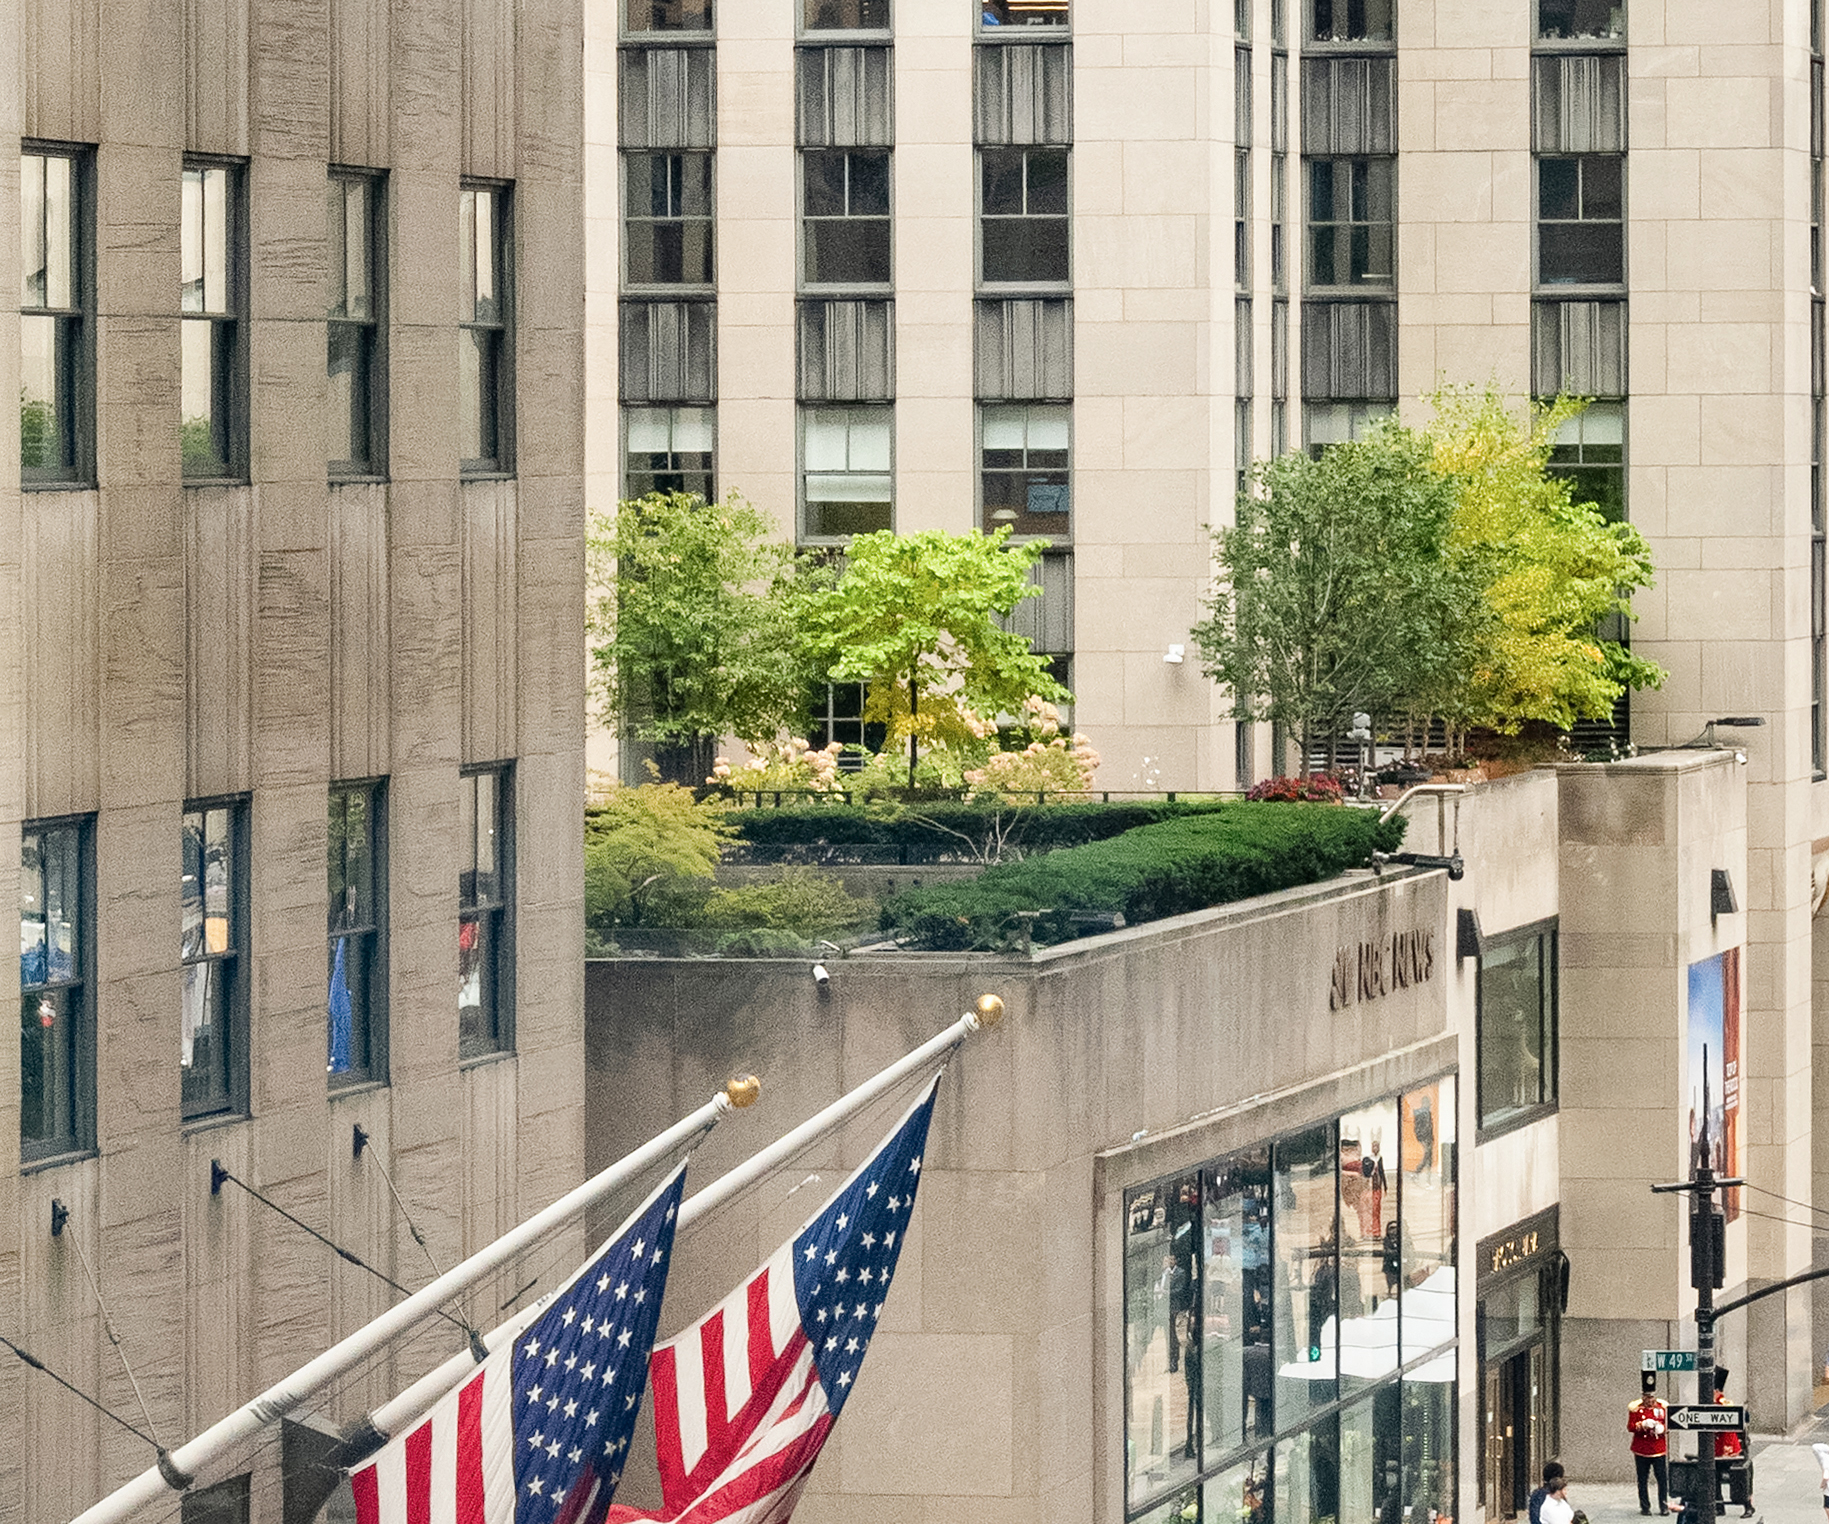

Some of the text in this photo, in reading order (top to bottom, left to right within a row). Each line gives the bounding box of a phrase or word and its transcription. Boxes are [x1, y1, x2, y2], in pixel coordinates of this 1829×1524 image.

[1657, 1353, 1666, 1368] W
[1669, 1353, 1683, 1368] 49
[1678, 1413, 1734, 1423] ONE WAY
